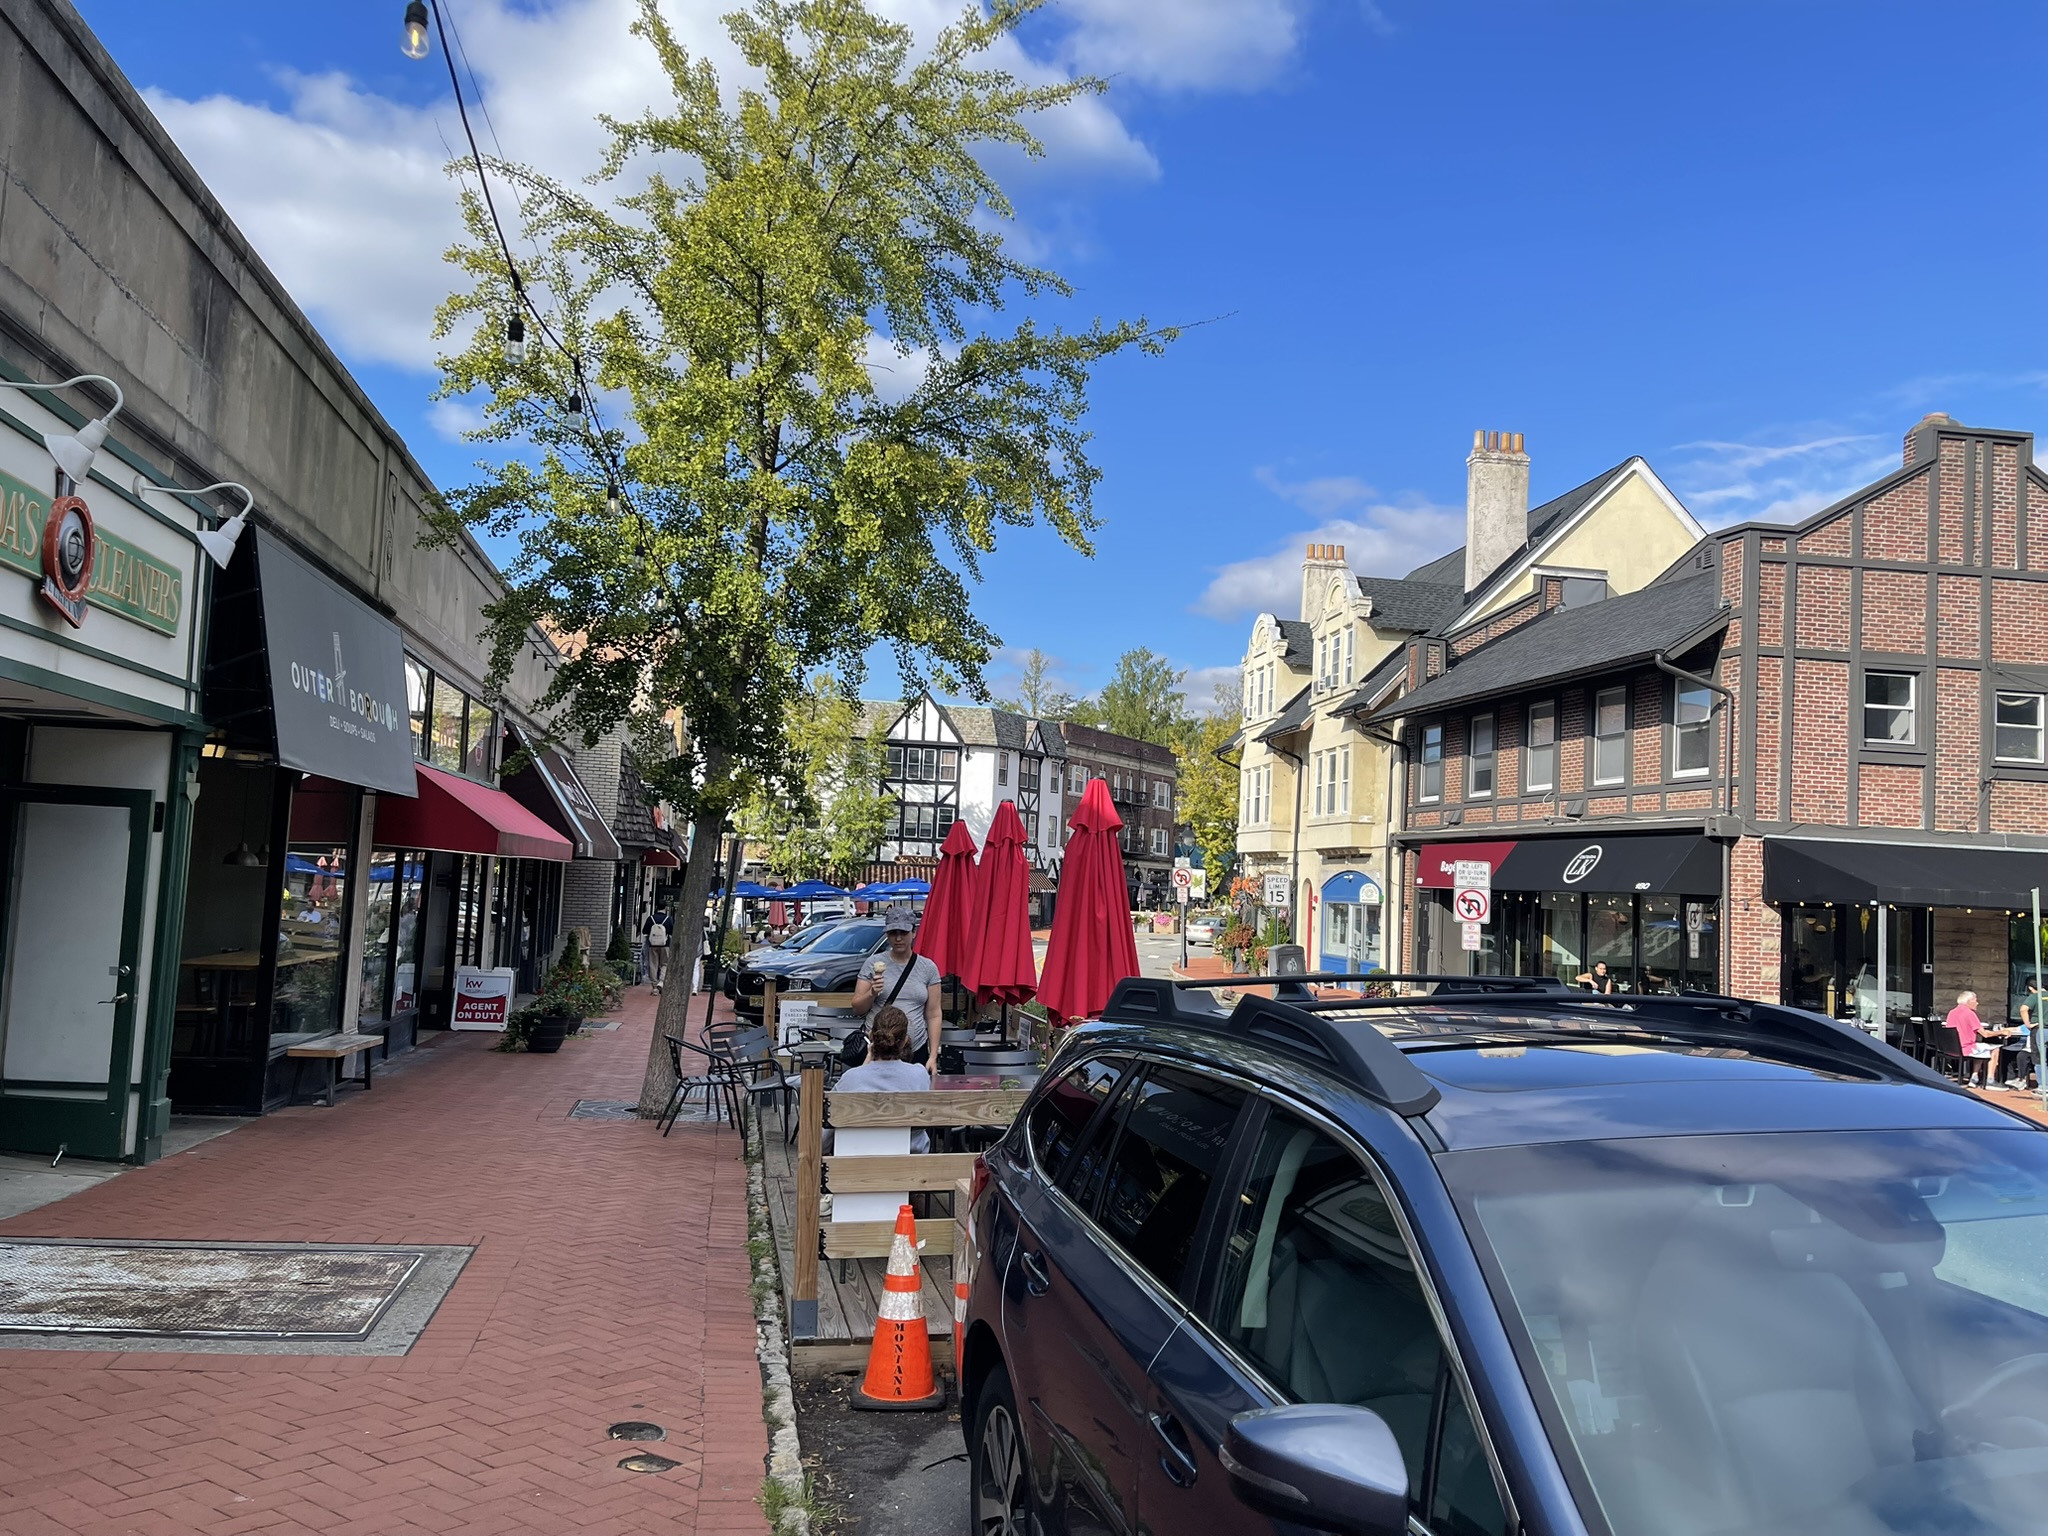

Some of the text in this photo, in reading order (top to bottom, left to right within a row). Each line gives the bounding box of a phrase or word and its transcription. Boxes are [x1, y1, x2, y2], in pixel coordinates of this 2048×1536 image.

[88, 533, 181, 624] CLEANERS
[291, 661, 334, 703] OUTER
[329, 715, 376, 743] DELI SOUPS SALADS
[910, 857, 937, 865] NAILS
[1567, 859, 1594, 875] LK
[1270, 891, 1285, 902] 15
[465, 977, 483, 989] kw
[463, 1002, 499, 1011] AGENT
[457, 1011, 503, 1020] ON DUTY
[893, 1323, 905, 1396] MONTANA
